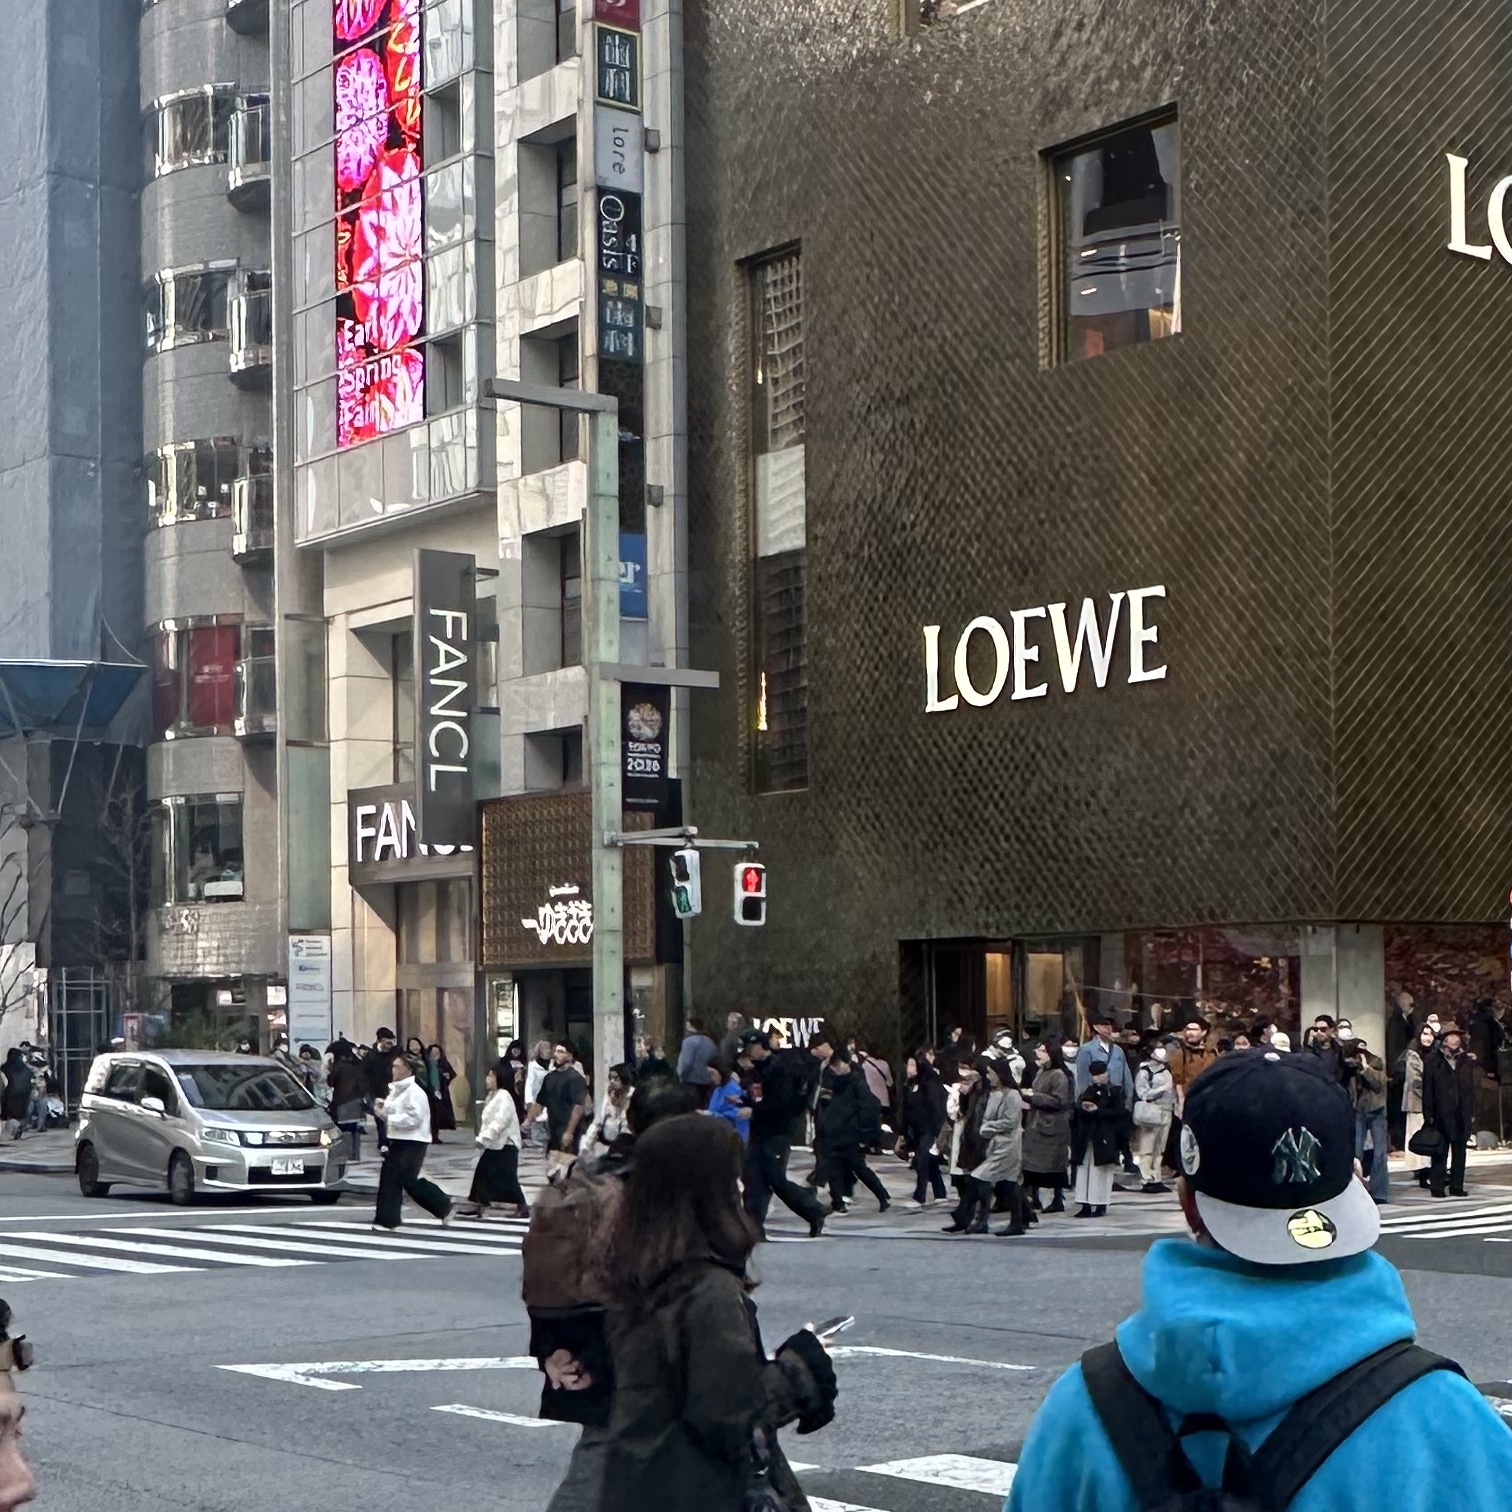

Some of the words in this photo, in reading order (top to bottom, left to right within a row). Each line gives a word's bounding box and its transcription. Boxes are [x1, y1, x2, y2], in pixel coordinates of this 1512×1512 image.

[429, 608, 469, 791] FANCL
[924, 585, 1167, 713] LOEWE
[357, 800, 473, 862] FAN
